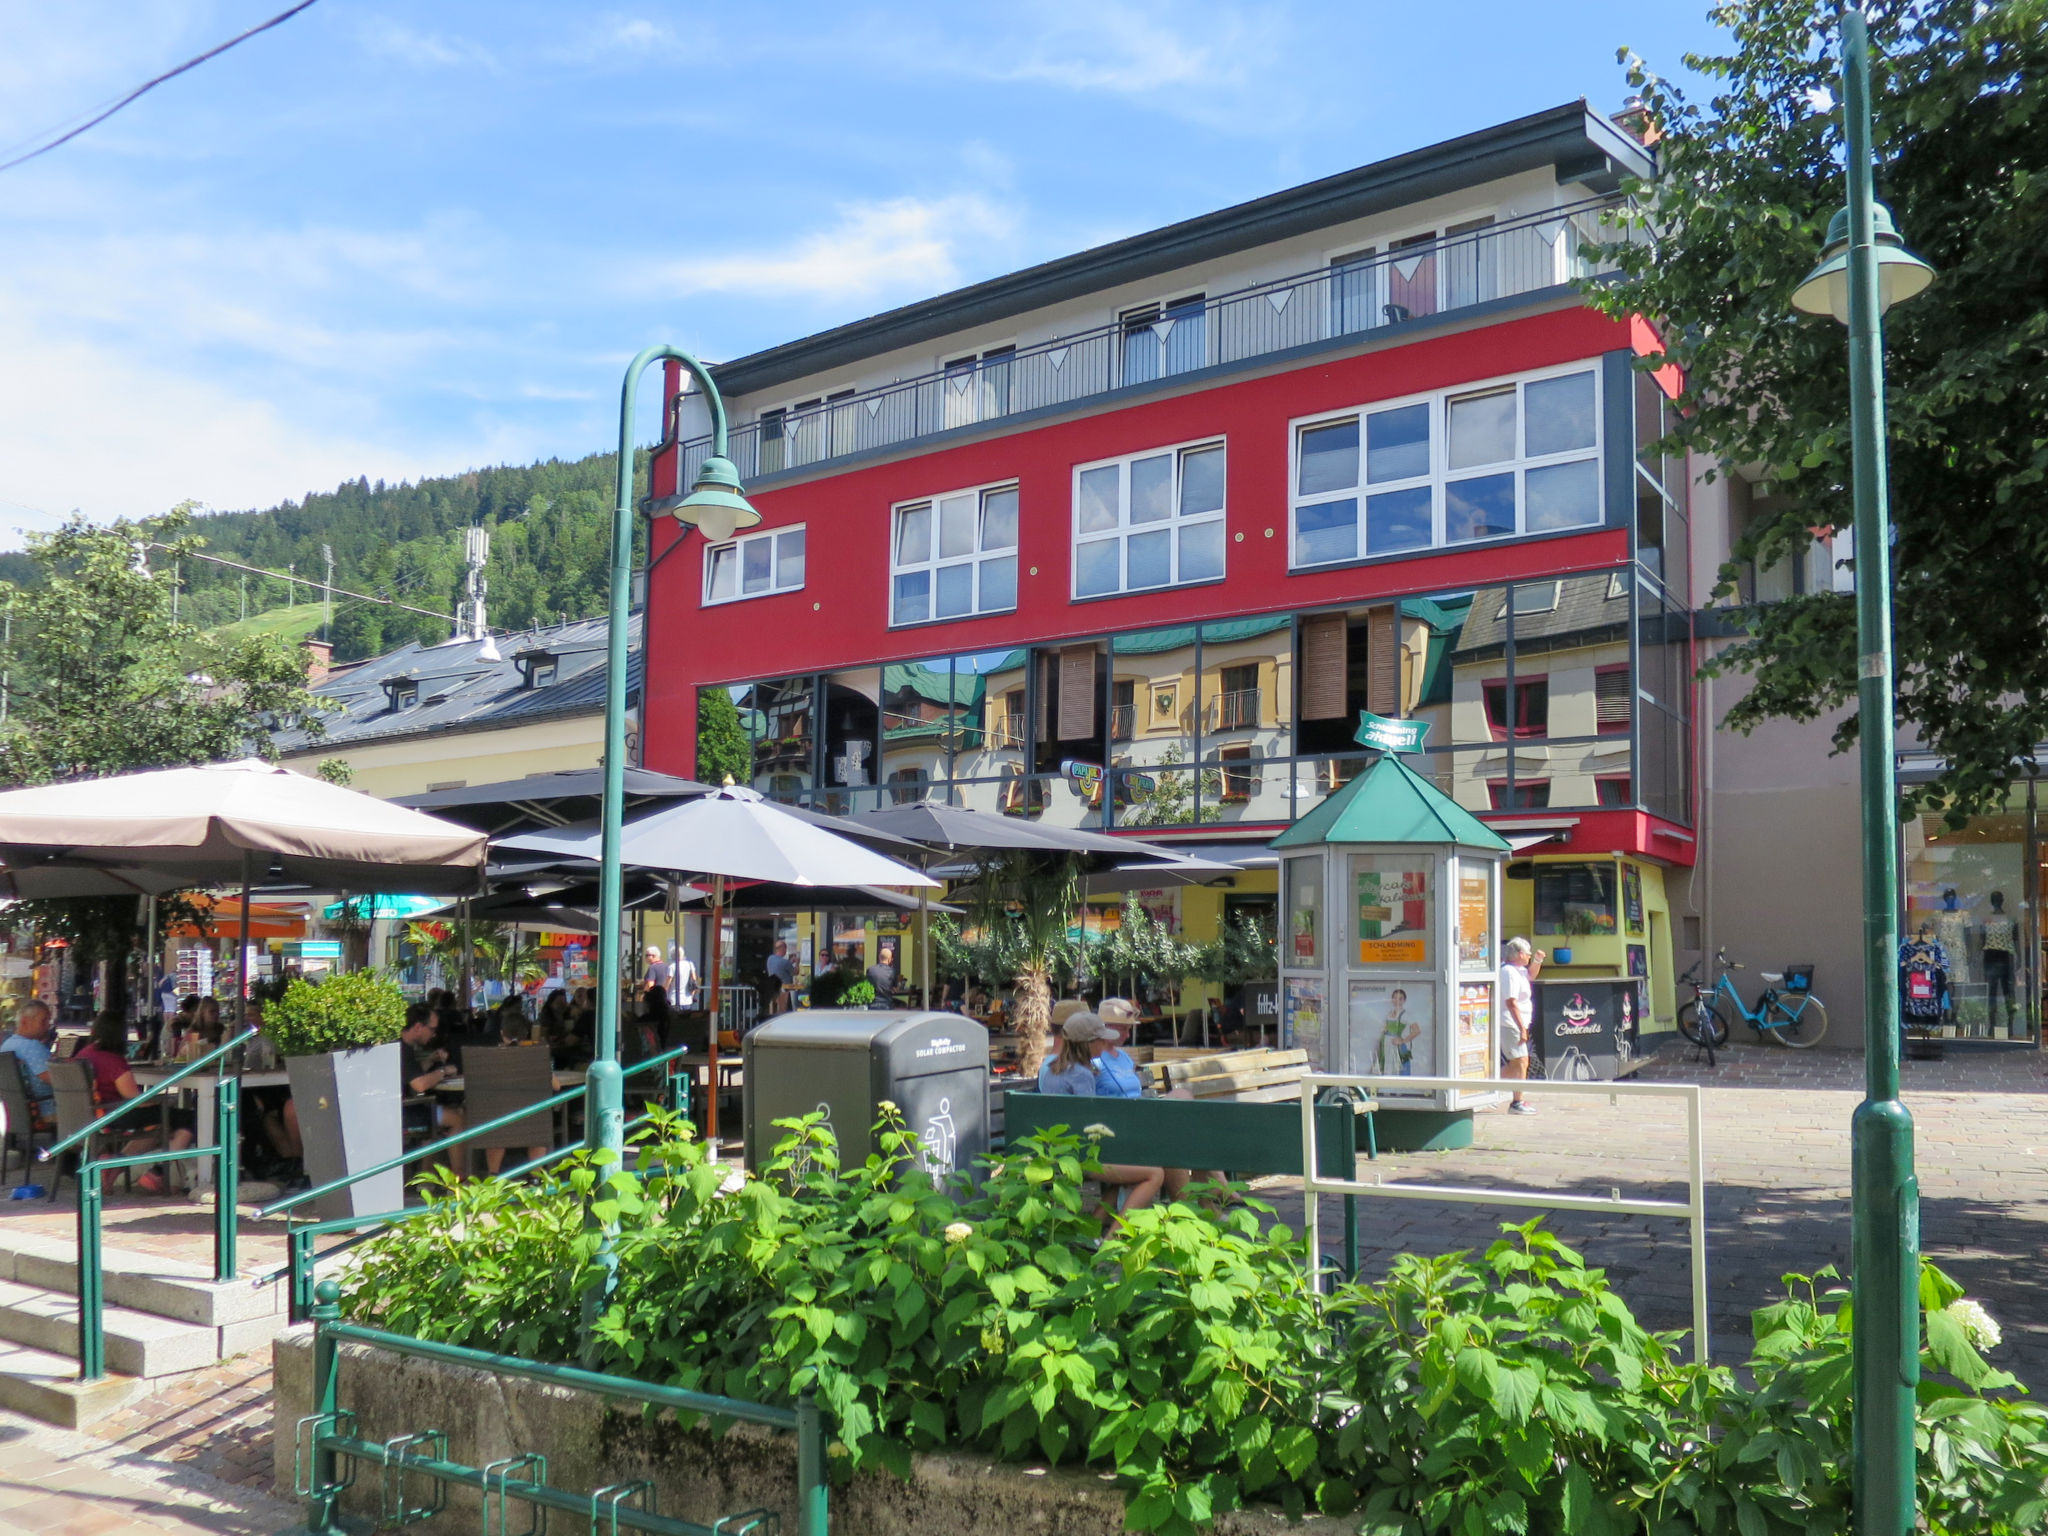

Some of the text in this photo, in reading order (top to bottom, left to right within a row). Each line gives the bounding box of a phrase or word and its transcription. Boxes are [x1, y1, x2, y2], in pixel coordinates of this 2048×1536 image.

[1555, 1023, 1602, 1036] Cocktails
[916, 1044, 966, 1058] SOLAR COMPACTOR
